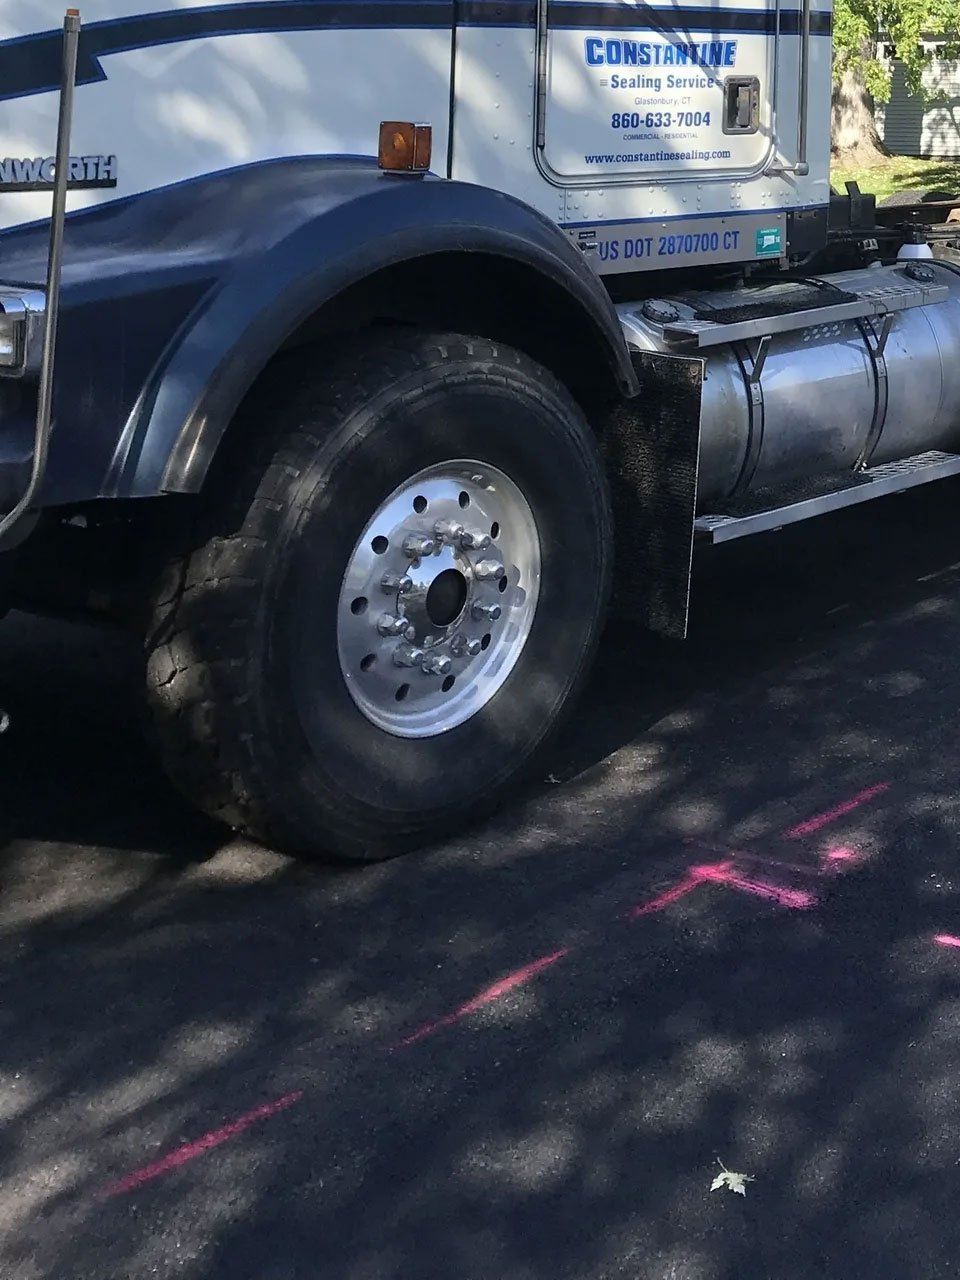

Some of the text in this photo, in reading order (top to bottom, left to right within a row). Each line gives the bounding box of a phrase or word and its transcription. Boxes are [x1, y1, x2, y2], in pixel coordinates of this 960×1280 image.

[585, 36, 737, 67] CONSTANTINE
[611, 74, 714, 92] Sealing Service
[634, 96, 692, 106] Glastonbury, CT
[611, 111, 711, 129] 860-633-7004
[623, 132, 699, 141] COMMERCIAL RESIDENTIAL
[584, 150, 731, 164] www.constantinesealing.com
[599, 240, 619, 261] US
[624, 237, 653, 259] DOT
[657, 231, 719, 256] 2870700
[723, 230, 740, 250] CT
